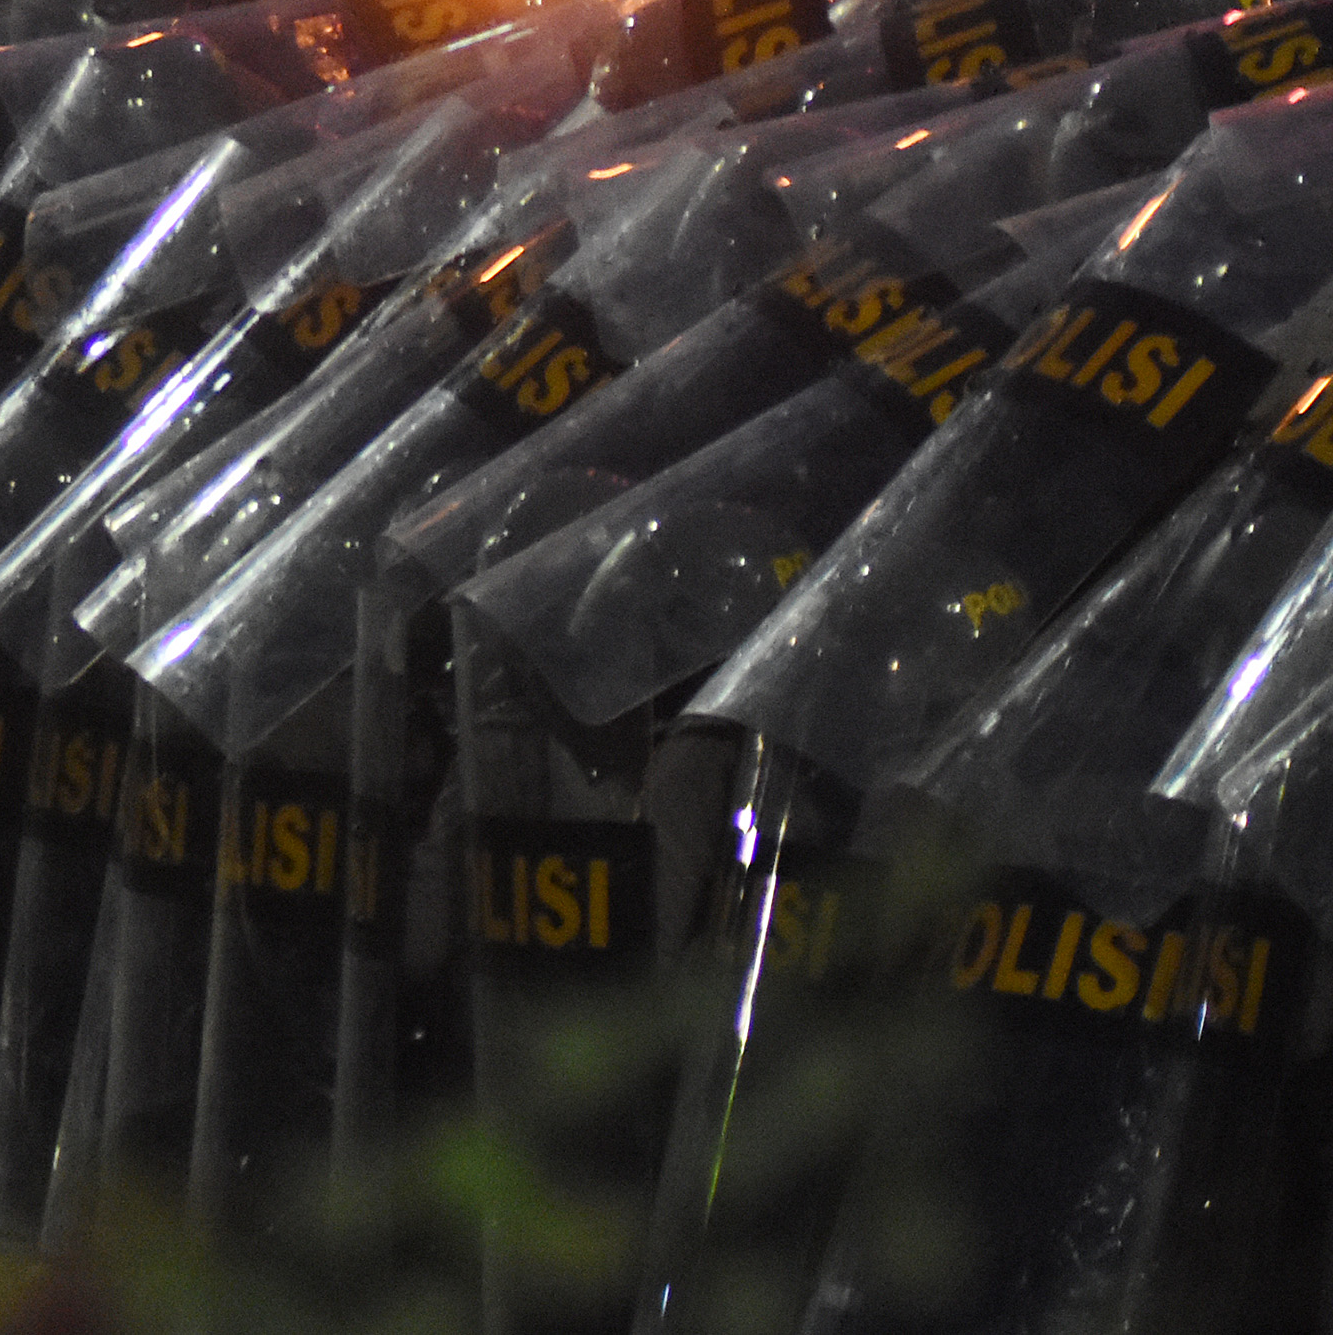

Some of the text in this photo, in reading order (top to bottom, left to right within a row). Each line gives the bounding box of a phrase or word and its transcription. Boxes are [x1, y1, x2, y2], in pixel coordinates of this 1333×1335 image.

[1000, 303, 1216, 430] OLISI
[477, 849, 610, 949] LISI
[951, 902, 1185, 1022] OLISI
